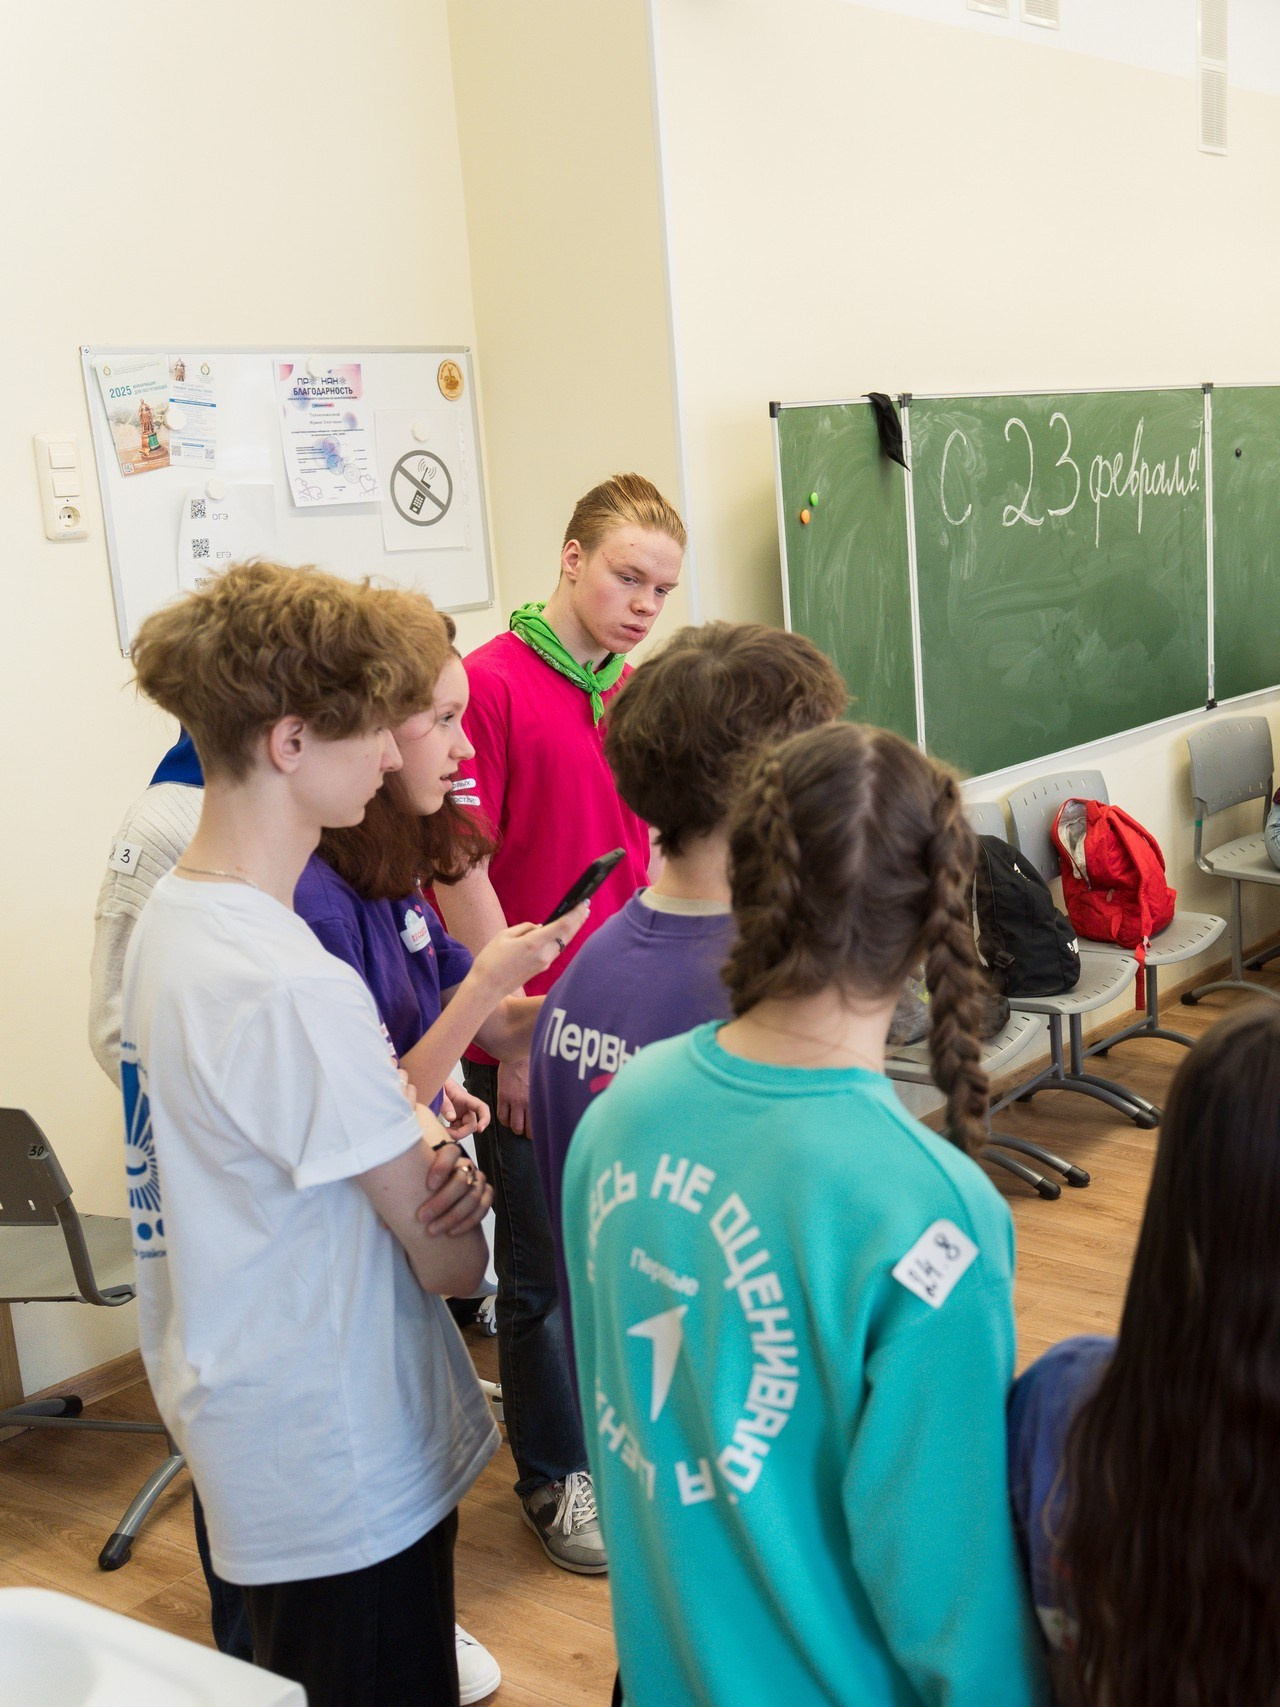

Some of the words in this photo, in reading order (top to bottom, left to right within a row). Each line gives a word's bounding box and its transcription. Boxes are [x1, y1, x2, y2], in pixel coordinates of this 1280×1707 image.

[109, 385, 132, 399] 2025
[293, 387, 353, 396] БЛАГОДАРНОСТЬ
[940, 429, 972, 525] С
[1001, 412, 1081, 527] 23
[212, 513, 229, 521] ОГЭ
[216, 551, 232, 559] ЕГЭ
[650, 1153, 717, 1215] НЕ
[709, 1191, 800, 1500] ОЦЕНИВАЮ
